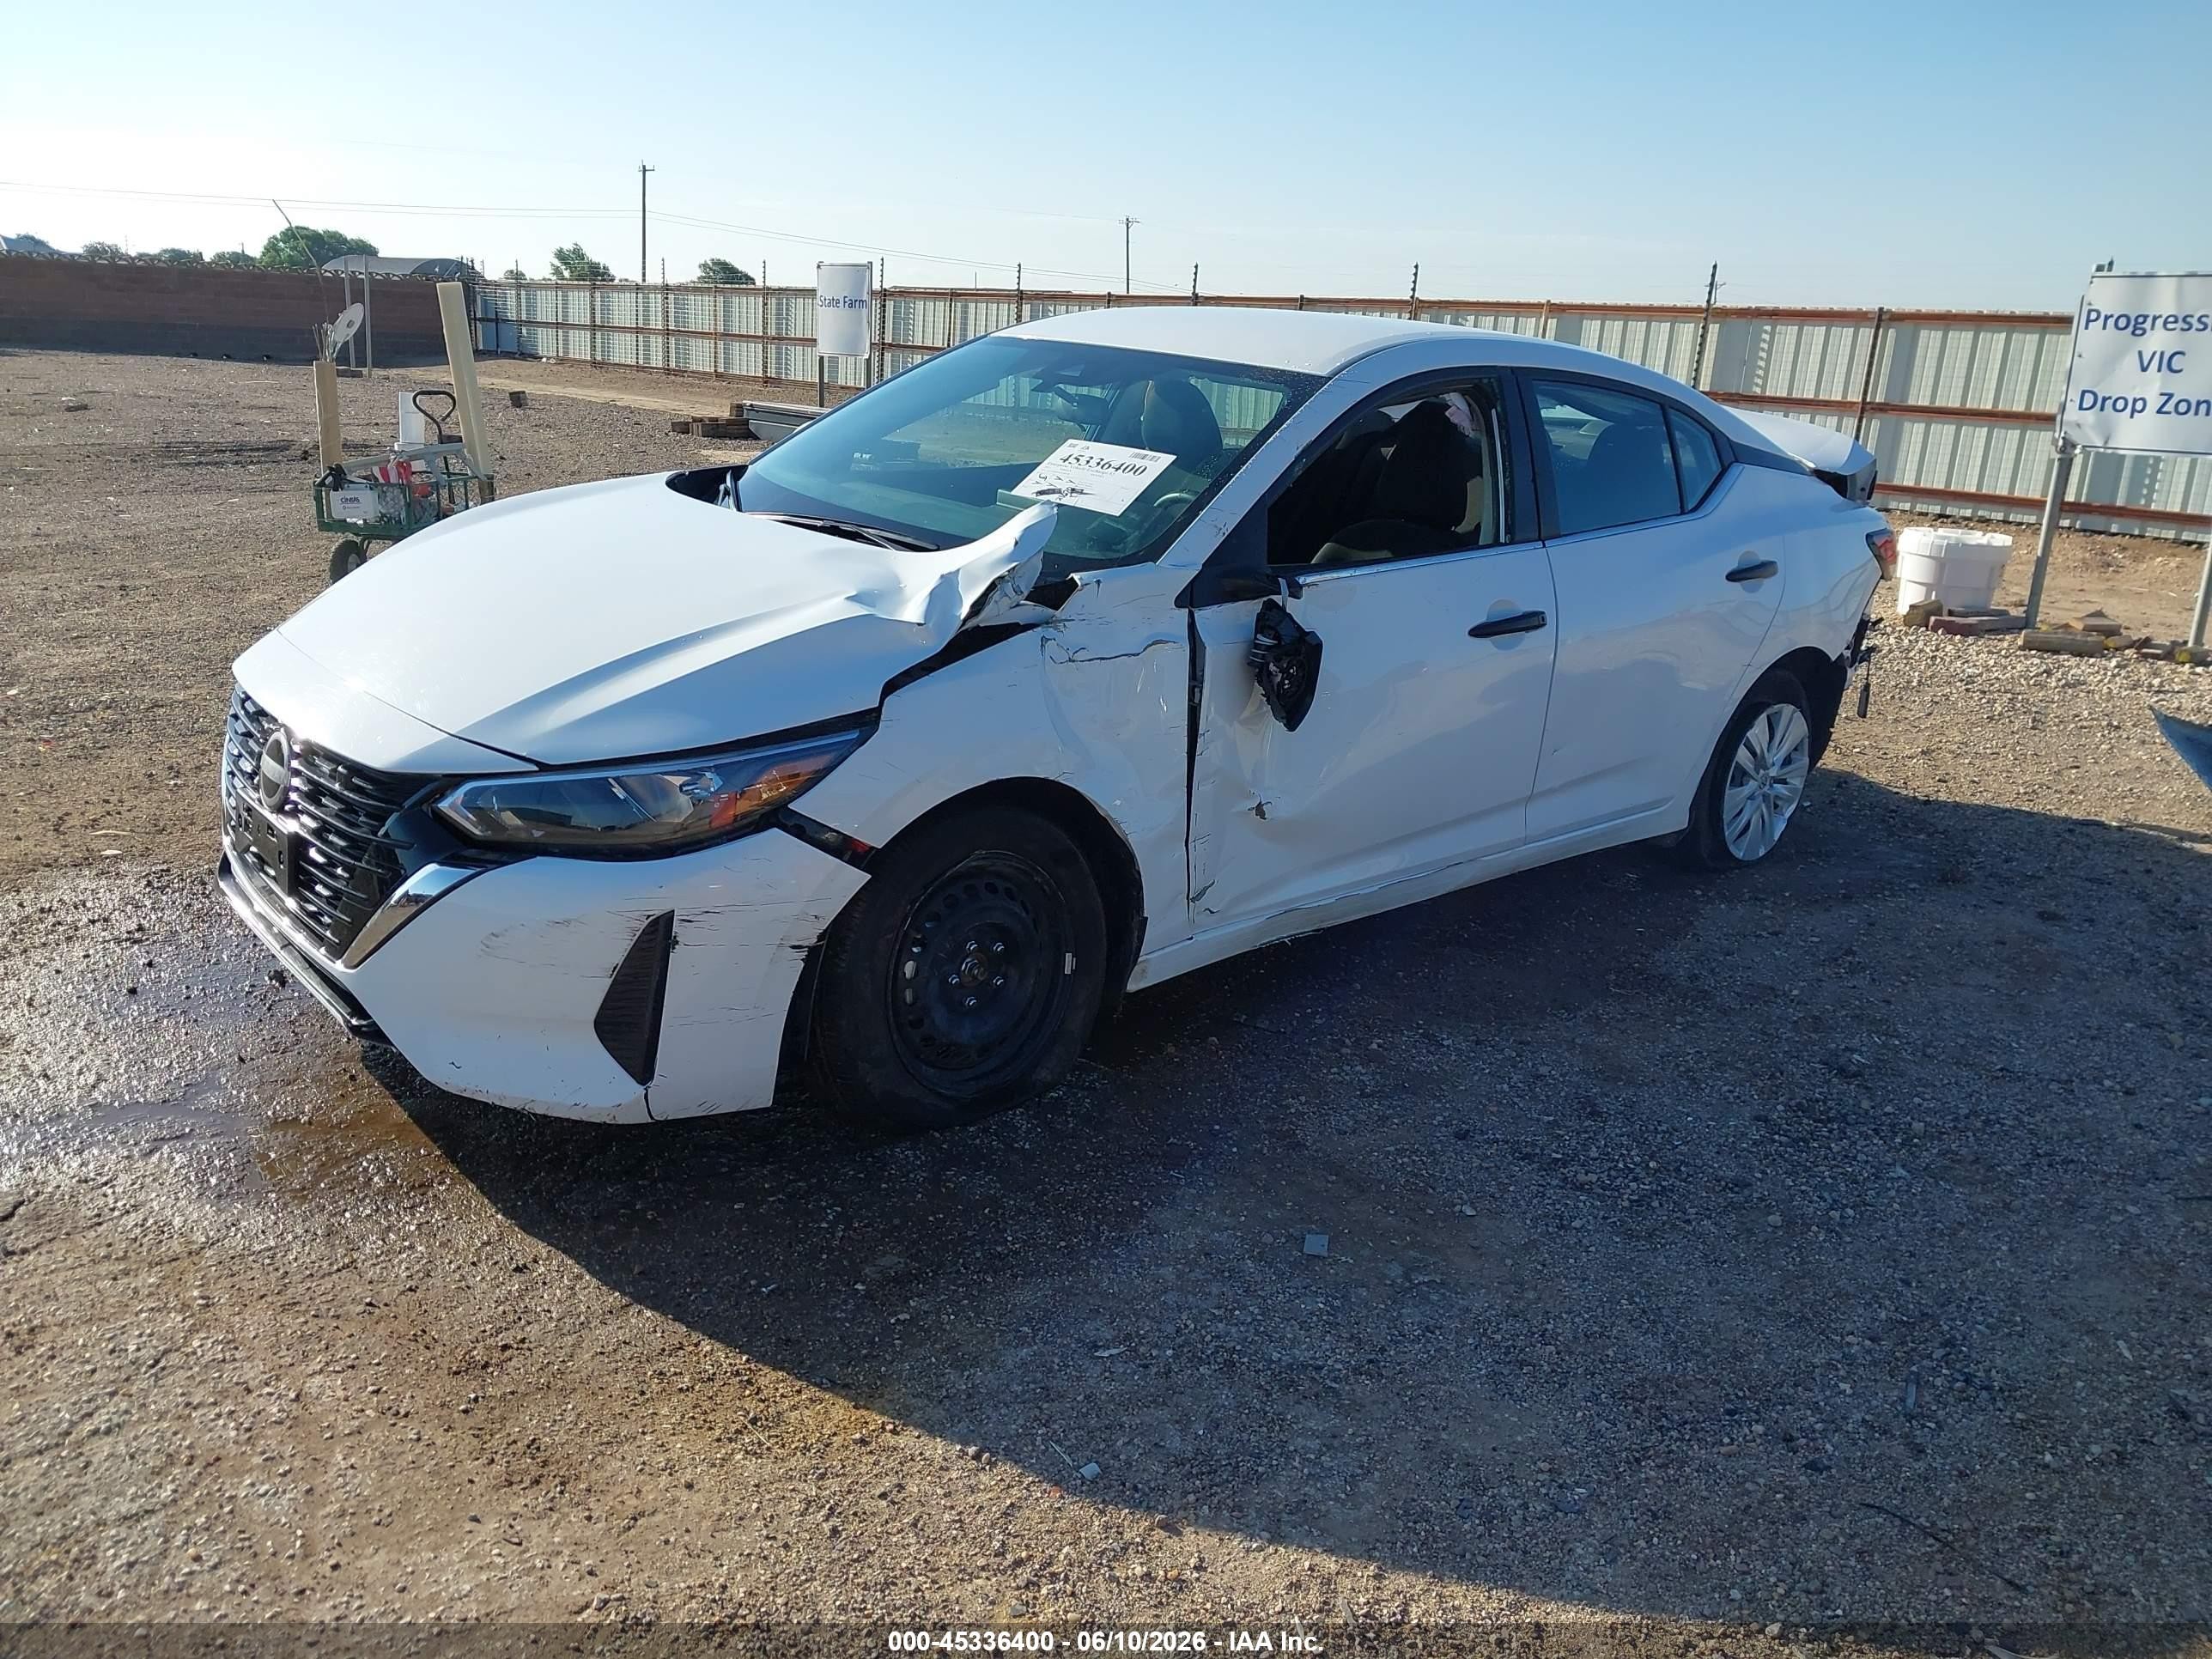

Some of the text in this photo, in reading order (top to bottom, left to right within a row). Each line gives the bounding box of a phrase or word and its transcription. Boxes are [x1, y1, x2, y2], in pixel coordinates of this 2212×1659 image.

[819, 295, 867, 310] State Farm
[2084, 308, 2212, 337] Progress
[2137, 350, 2185, 374] VIC
[2078, 389, 2148, 419] Drop
[1060, 453, 1147, 477] 45336400
